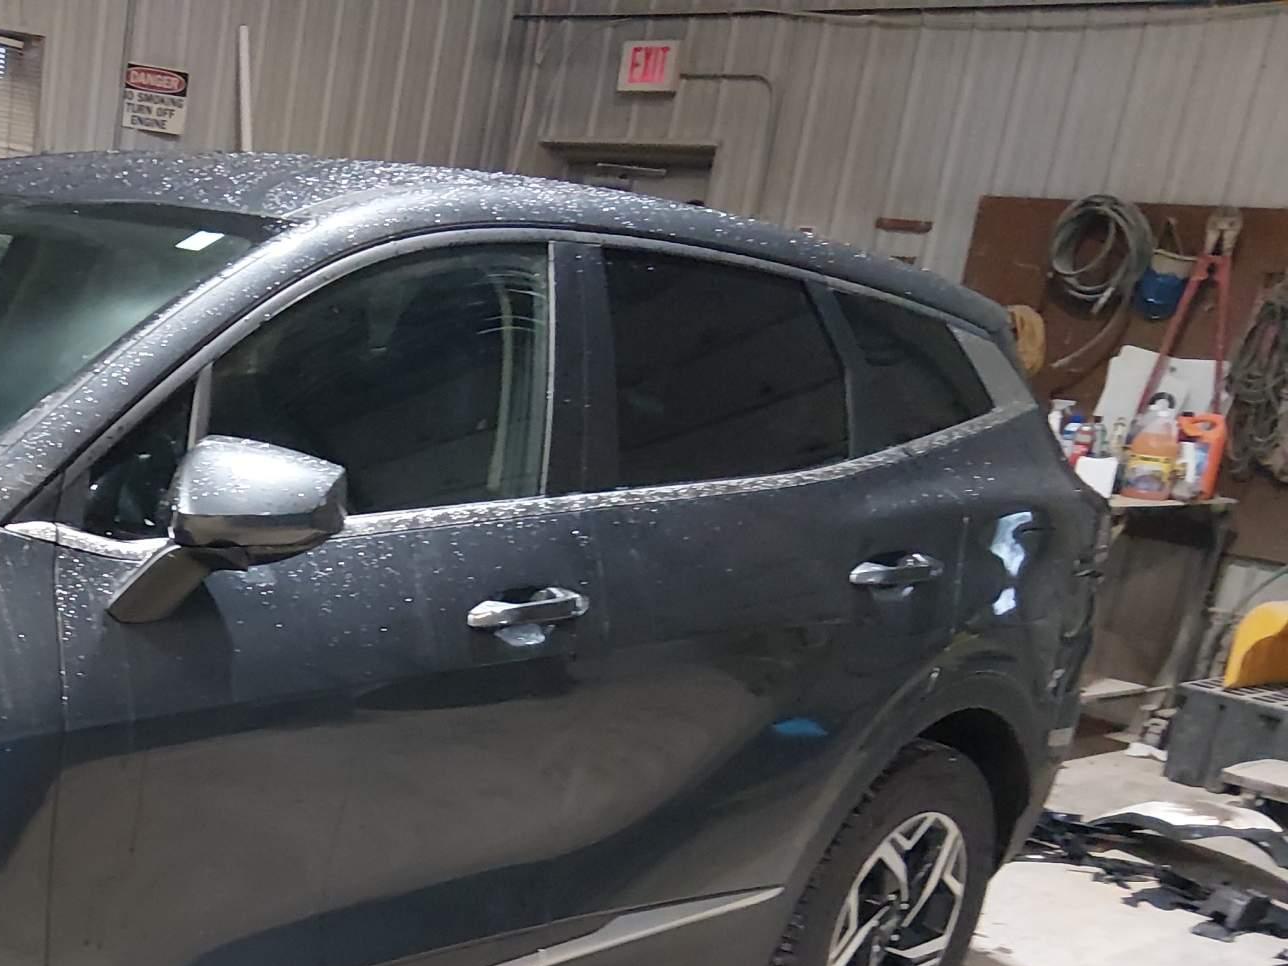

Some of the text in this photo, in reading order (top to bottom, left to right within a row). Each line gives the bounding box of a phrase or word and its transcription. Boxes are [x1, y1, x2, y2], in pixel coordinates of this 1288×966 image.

[628, 46, 670, 83] EXIT
[129, 70, 180, 90] DANGER
[137, 92, 185, 109] SMOKING
[126, 102, 176, 119] TURN OFF
[130, 114, 168, 130] ENGINE
